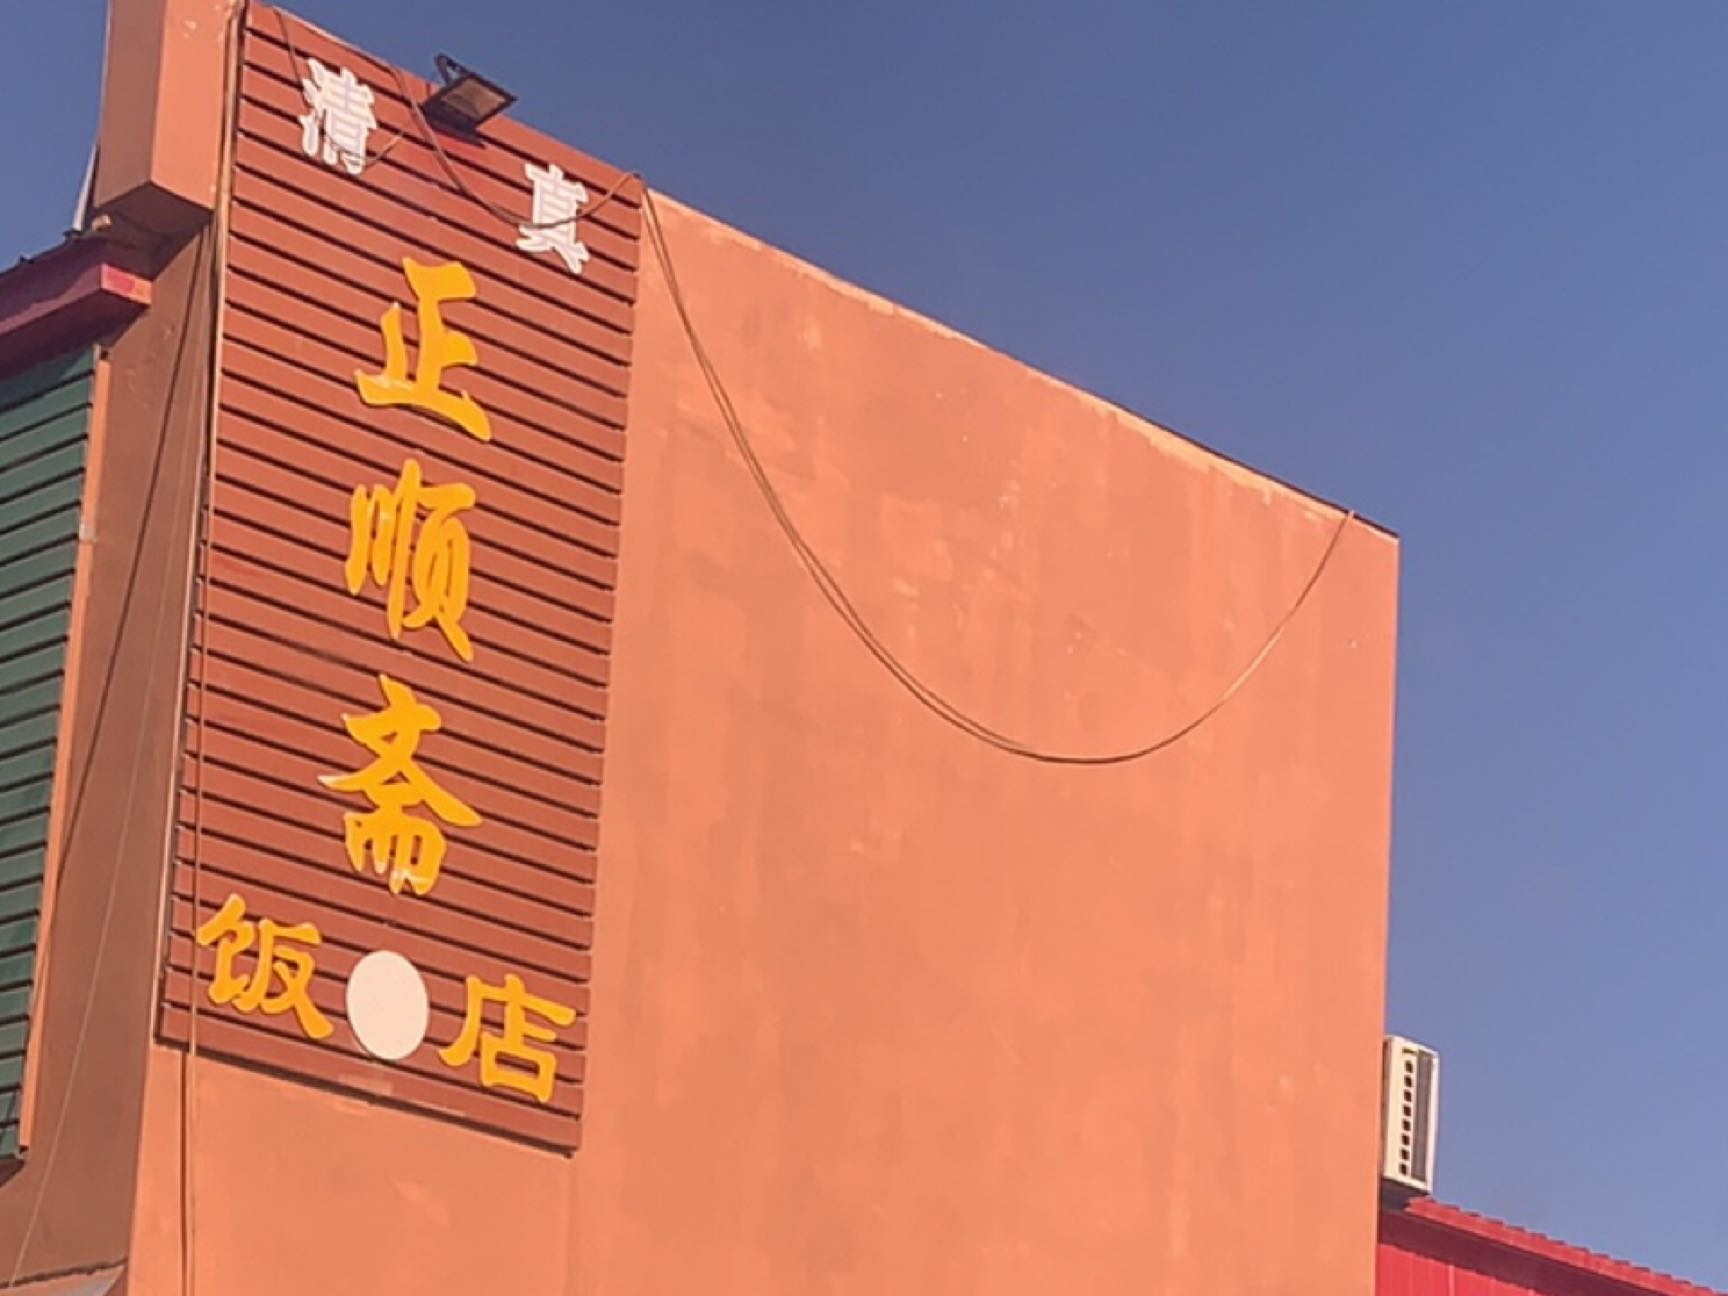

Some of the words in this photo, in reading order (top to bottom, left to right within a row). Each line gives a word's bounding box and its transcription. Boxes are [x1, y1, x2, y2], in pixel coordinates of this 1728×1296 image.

[318, 257, 492, 897] 正顺斋
[197, 893, 576, 1103] 饭店
